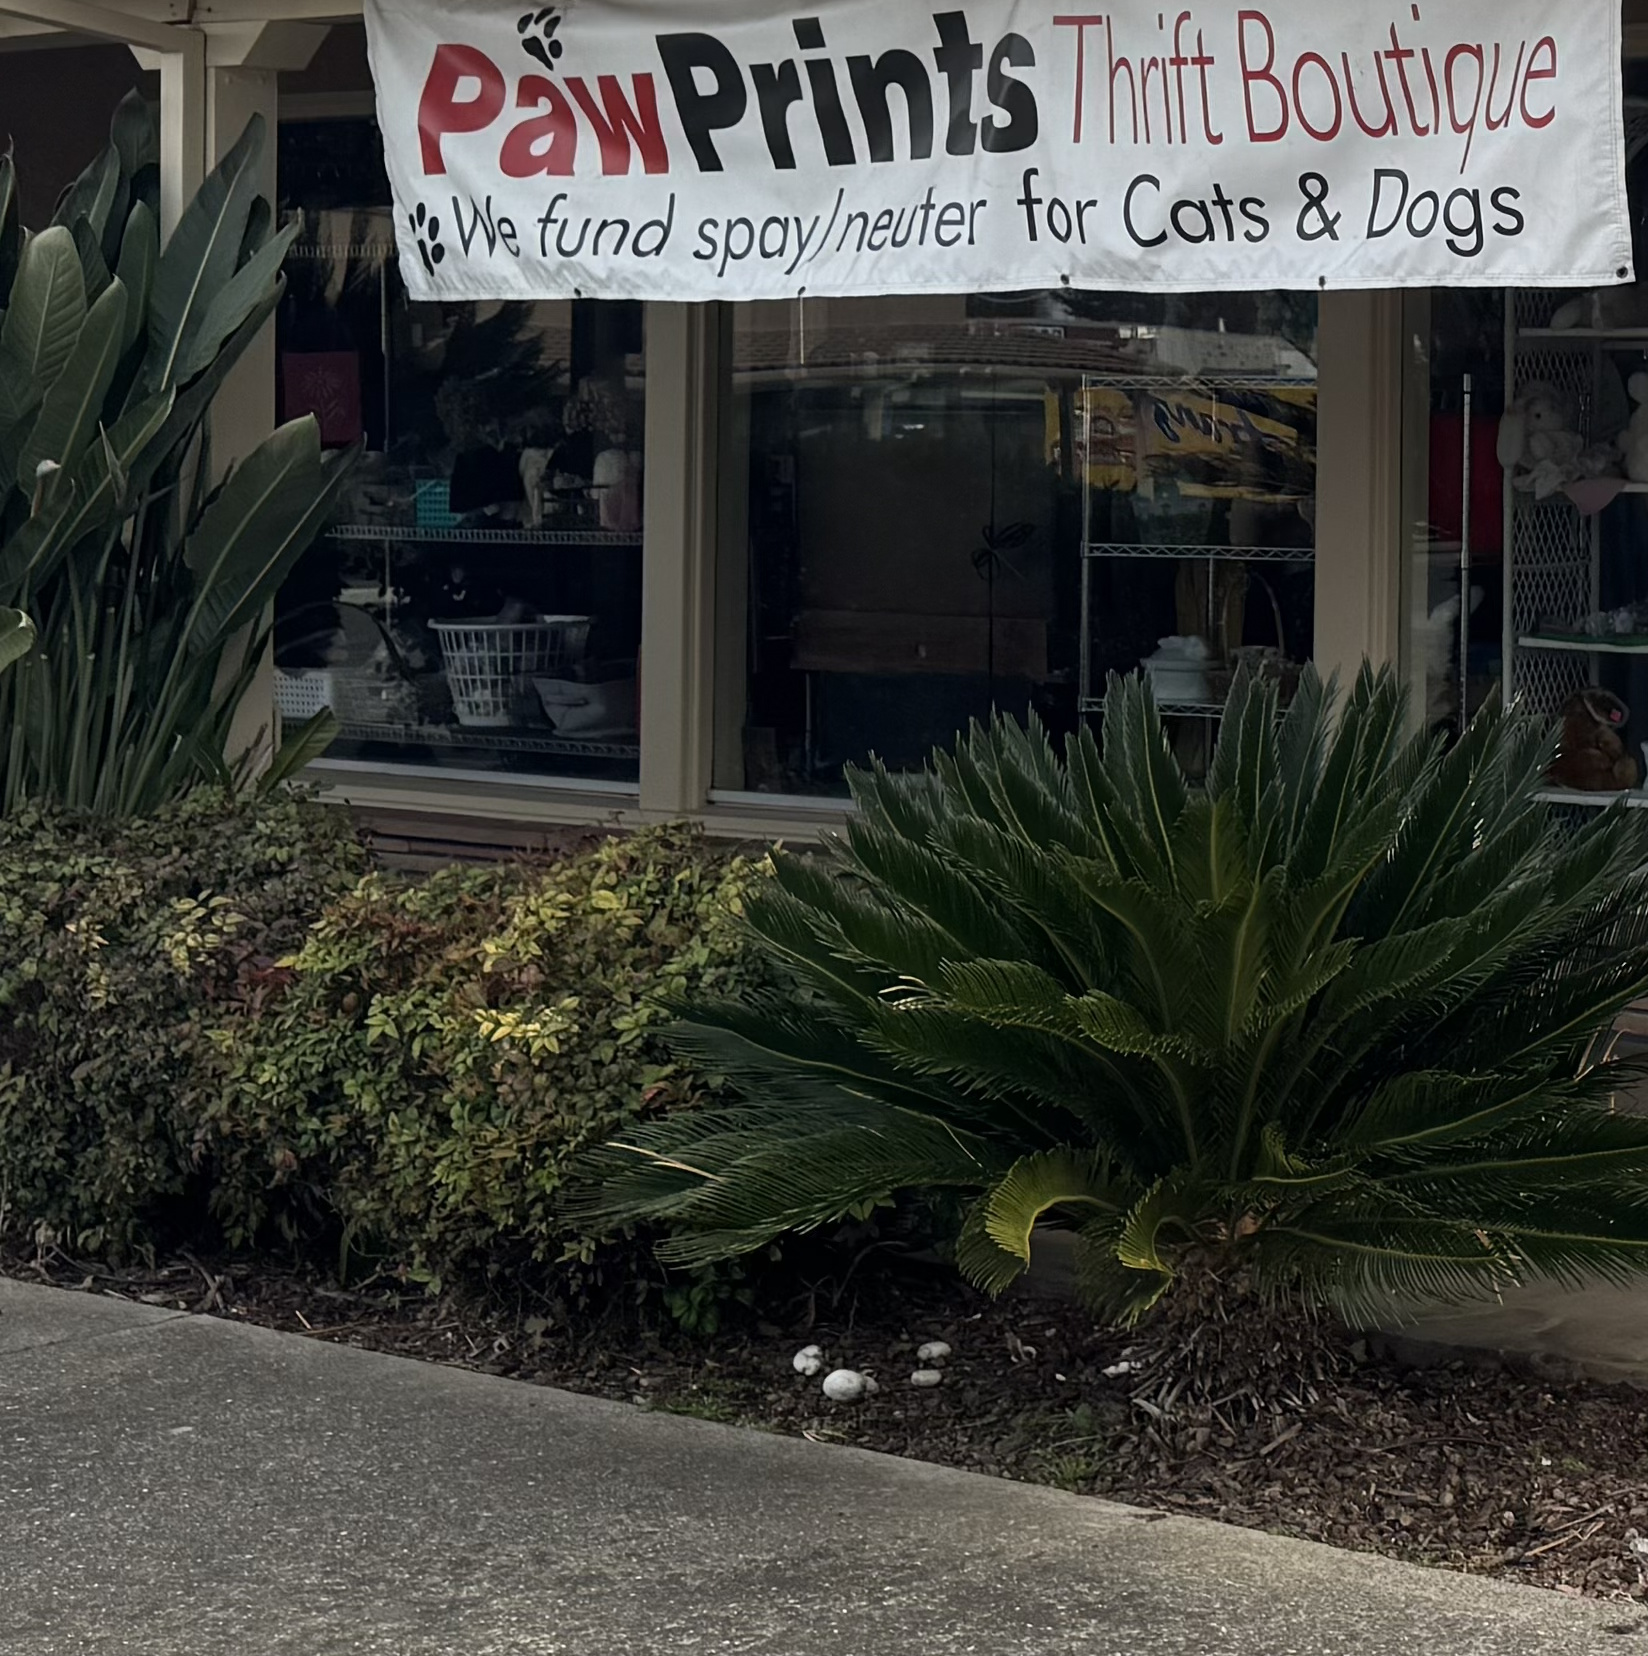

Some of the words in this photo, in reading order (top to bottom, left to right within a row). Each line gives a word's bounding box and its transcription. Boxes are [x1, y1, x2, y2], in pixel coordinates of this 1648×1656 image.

[417, 10, 1038, 179] PawPrints
[1053, 11, 1223, 145] Thrift
[1237, 4, 1557, 174] Boutique
[452, 195, 520, 259] We
[537, 193, 675, 259] fund
[692, 188, 988, 278] spay/neuter
[1017, 167, 1098, 244] for
[1123, 173, 1270, 248] Cats
[1296, 172, 1341, 242] &
[1366, 167, 1525, 257] Dogs
